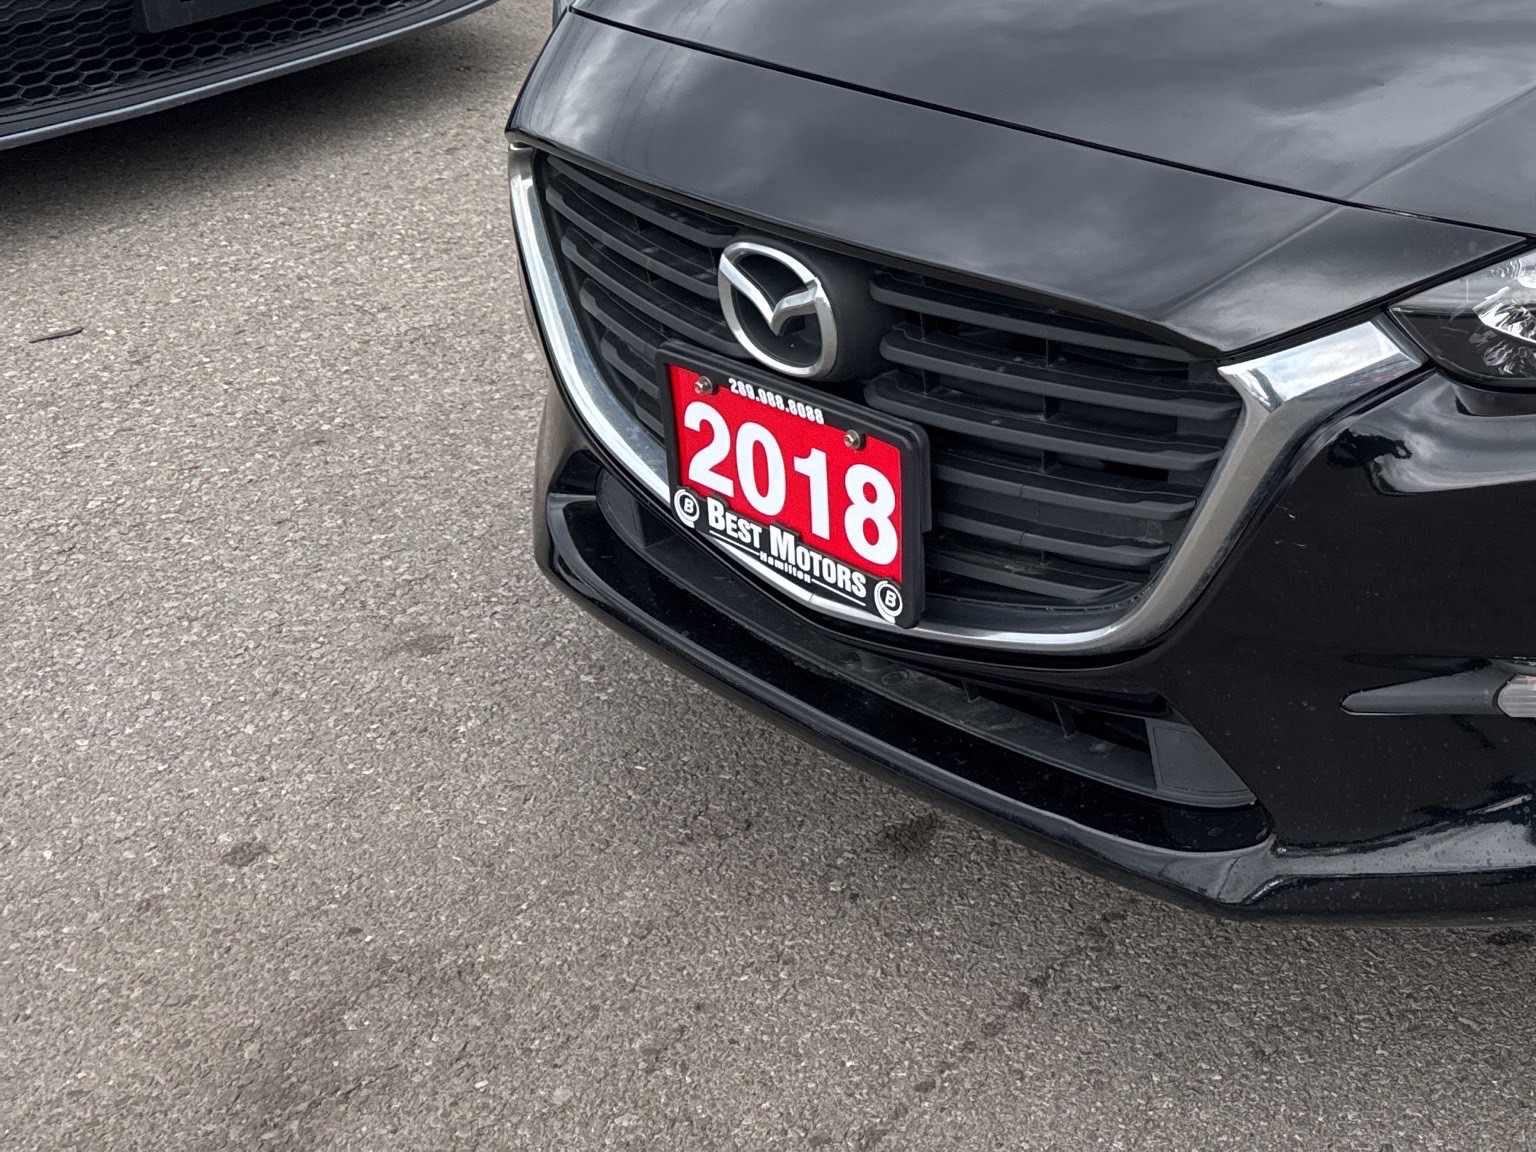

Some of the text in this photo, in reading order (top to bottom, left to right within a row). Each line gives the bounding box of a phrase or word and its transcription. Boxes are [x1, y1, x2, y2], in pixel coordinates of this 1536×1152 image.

[728, 377, 825, 425] 289.988.8088
[684, 401, 898, 565] 2018
[706, 496, 867, 598] BEST MOTORS
[759, 551, 811, 584] Hamilton
